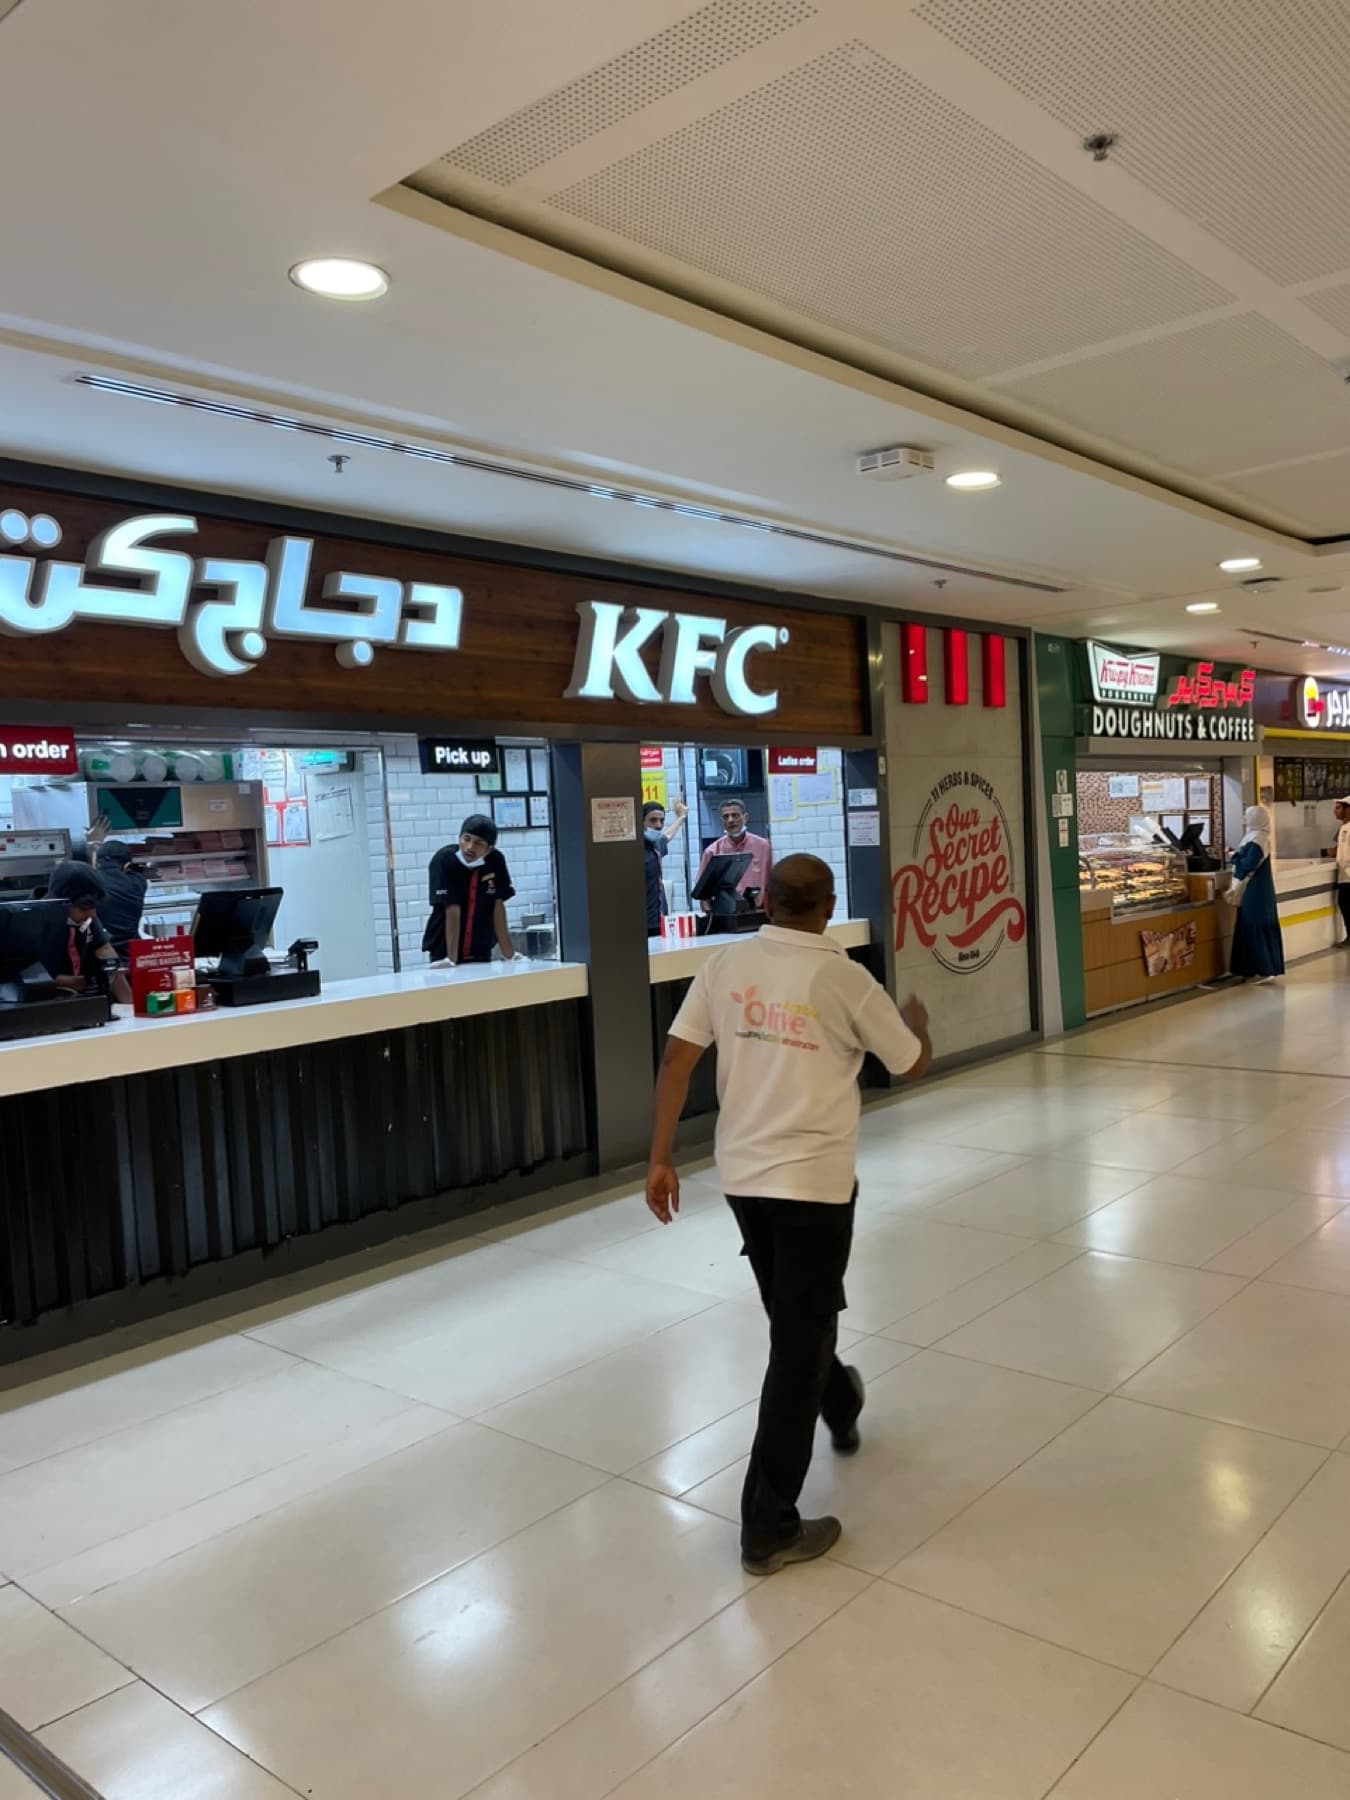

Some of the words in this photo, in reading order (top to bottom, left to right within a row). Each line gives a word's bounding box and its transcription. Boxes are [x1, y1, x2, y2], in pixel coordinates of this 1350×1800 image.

[182, 535, 463, 676] دجاج
[568, 601, 780, 716] KFC
[1093, 706, 1192, 739] DOUGHNUTS
[1197, 714, 1207, 738] &
[1210, 716, 1255, 741] COFFEE
[12, 740, 70, 759] order
[434, 746, 469, 764] Pick
[470, 751, 491, 768] up
[943, 803, 980, 837] Our
[923, 815, 1001, 881] Secret
[891, 854, 1010, 952] Recipe
